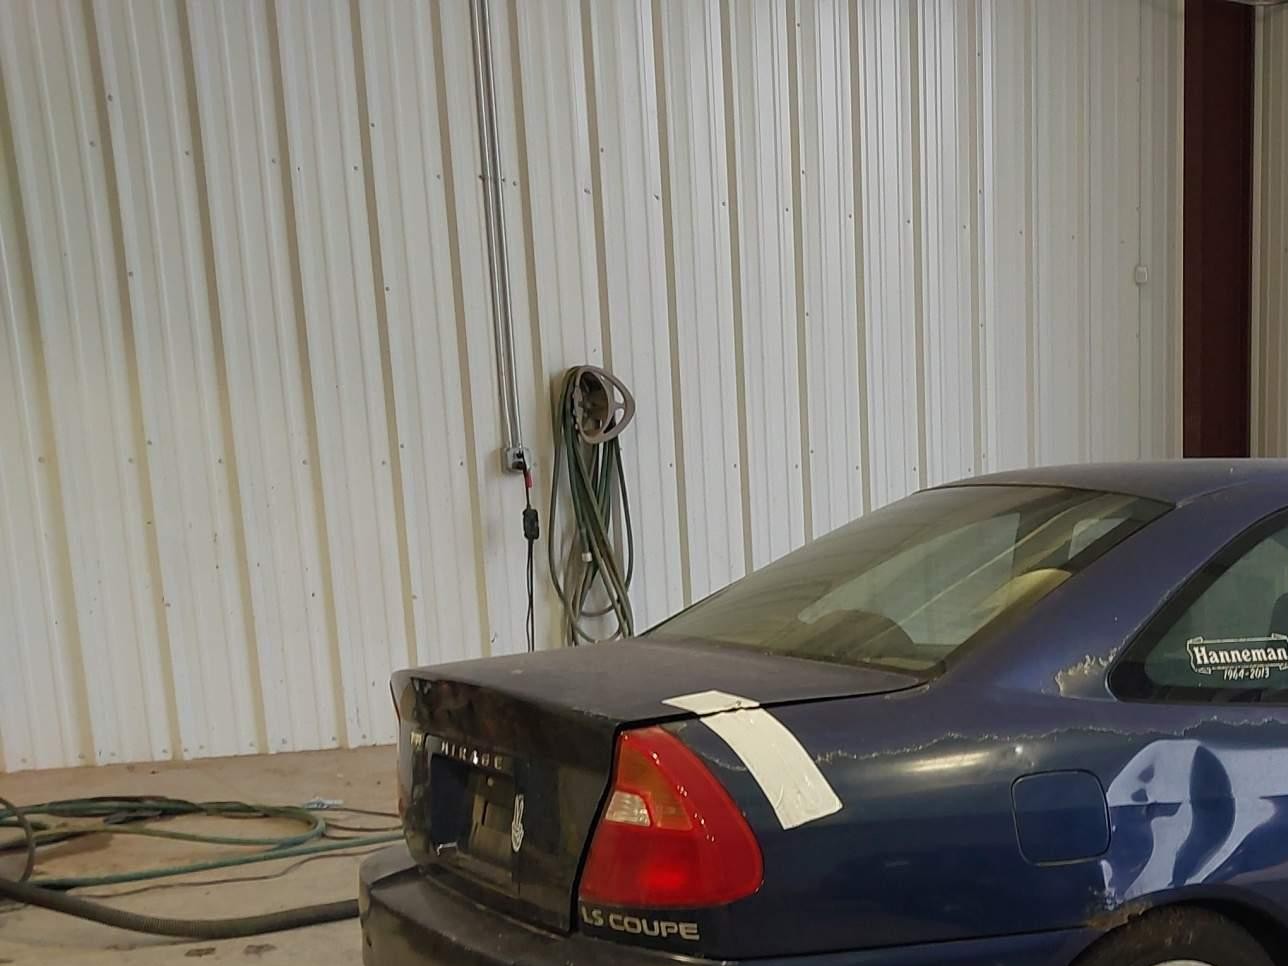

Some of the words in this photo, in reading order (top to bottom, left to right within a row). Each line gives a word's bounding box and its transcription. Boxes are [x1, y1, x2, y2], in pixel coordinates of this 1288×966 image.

[1193, 646, 1288, 665] Hanneman
[581, 906, 604, 926] LS
[609, 913, 700, 940] COUPE
